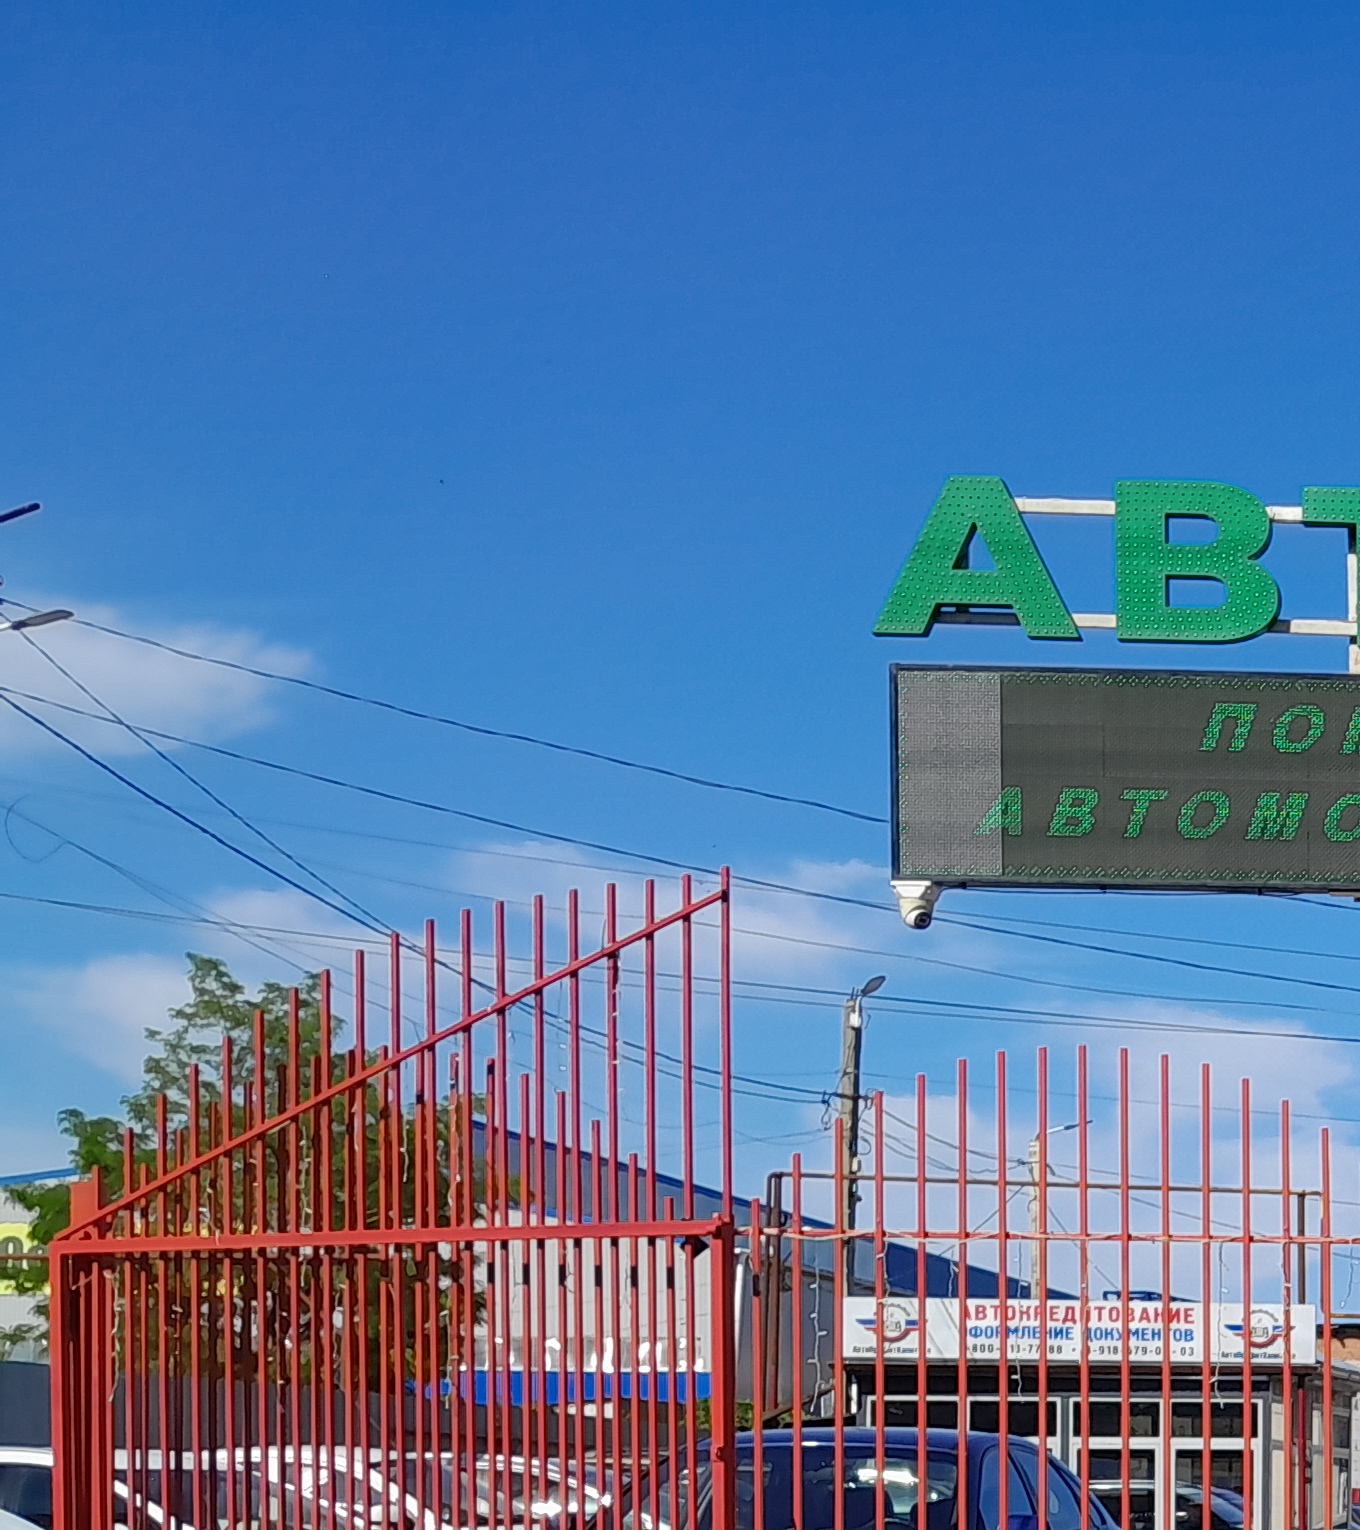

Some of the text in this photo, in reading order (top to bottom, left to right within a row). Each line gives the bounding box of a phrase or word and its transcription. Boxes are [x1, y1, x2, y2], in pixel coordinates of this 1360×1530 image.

[965, 1304, 1195, 1325] АВТОКРЕДТОВАНИЕ
[964, 1325, 1195, 1342] ФОМЛЕИЕ ОКУМЕНОВ
